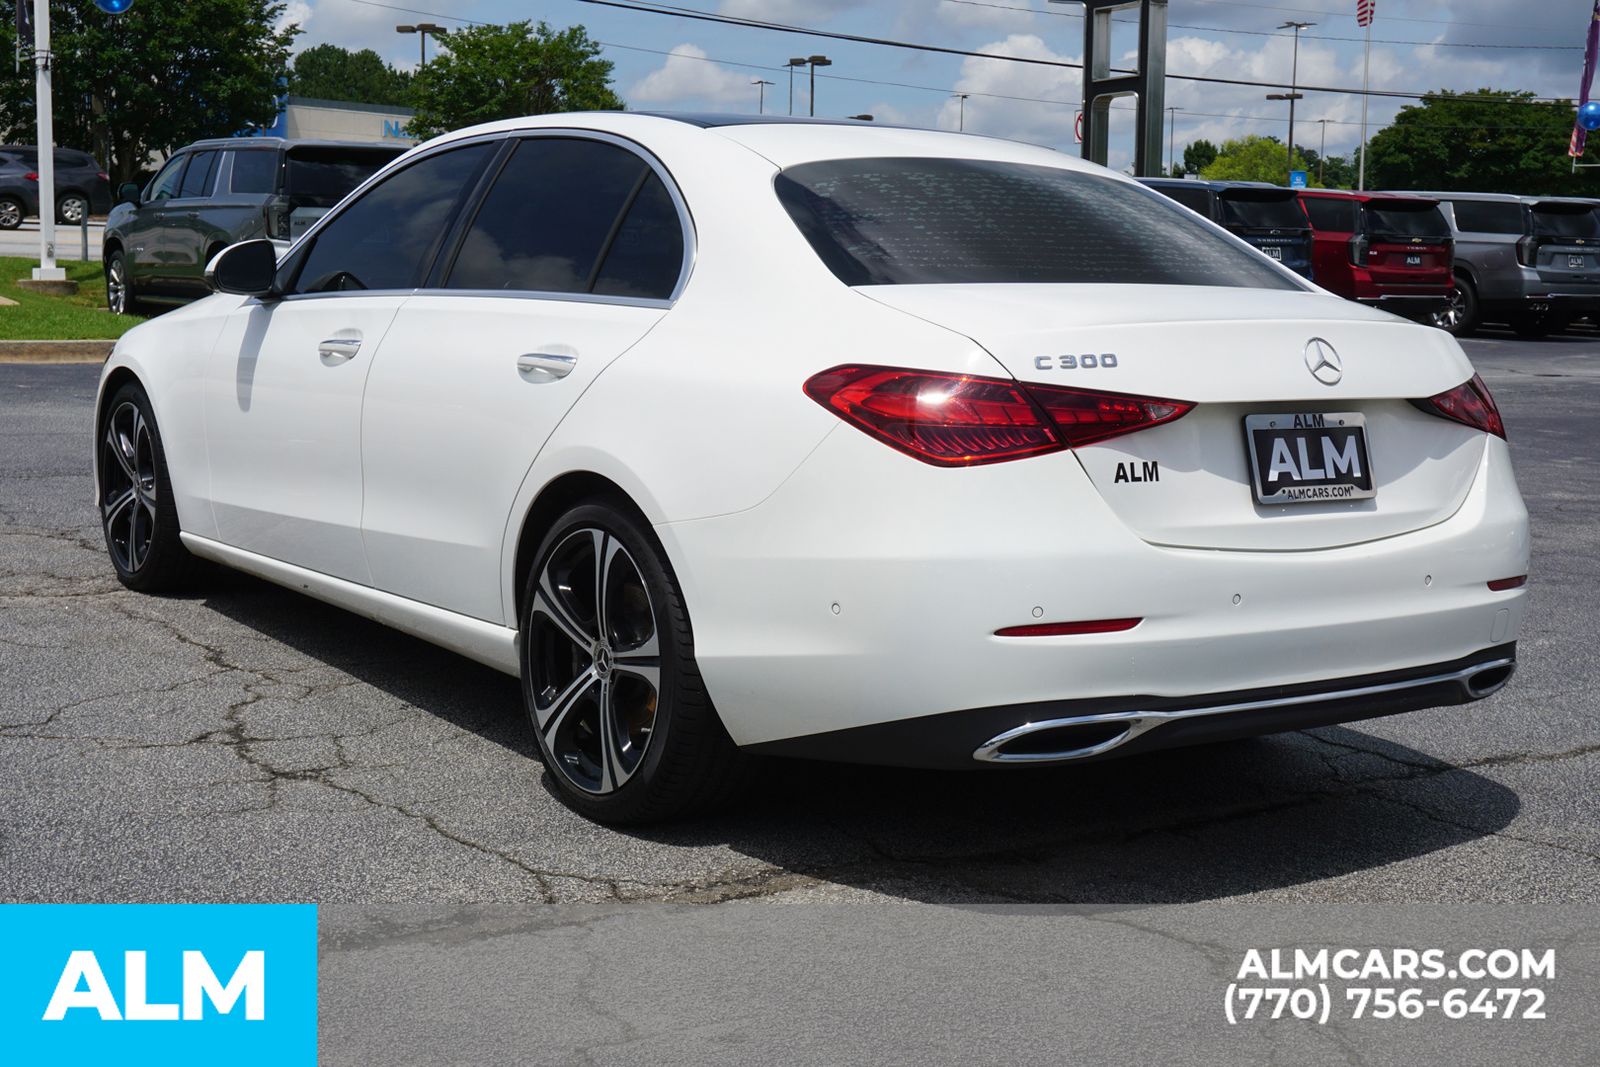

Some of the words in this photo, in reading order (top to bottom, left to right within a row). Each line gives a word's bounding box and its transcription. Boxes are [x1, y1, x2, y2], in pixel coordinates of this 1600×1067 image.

[1406, 256, 1421, 264] ALM
[1034, 356, 1053, 370] C
[1059, 354, 1118, 369] 300
[1294, 414, 1325, 428] ALM
[1268, 435, 1361, 481] ALM
[1114, 461, 1159, 483] ALM
[1287, 487, 1352, 500] ALMCARS.COM
